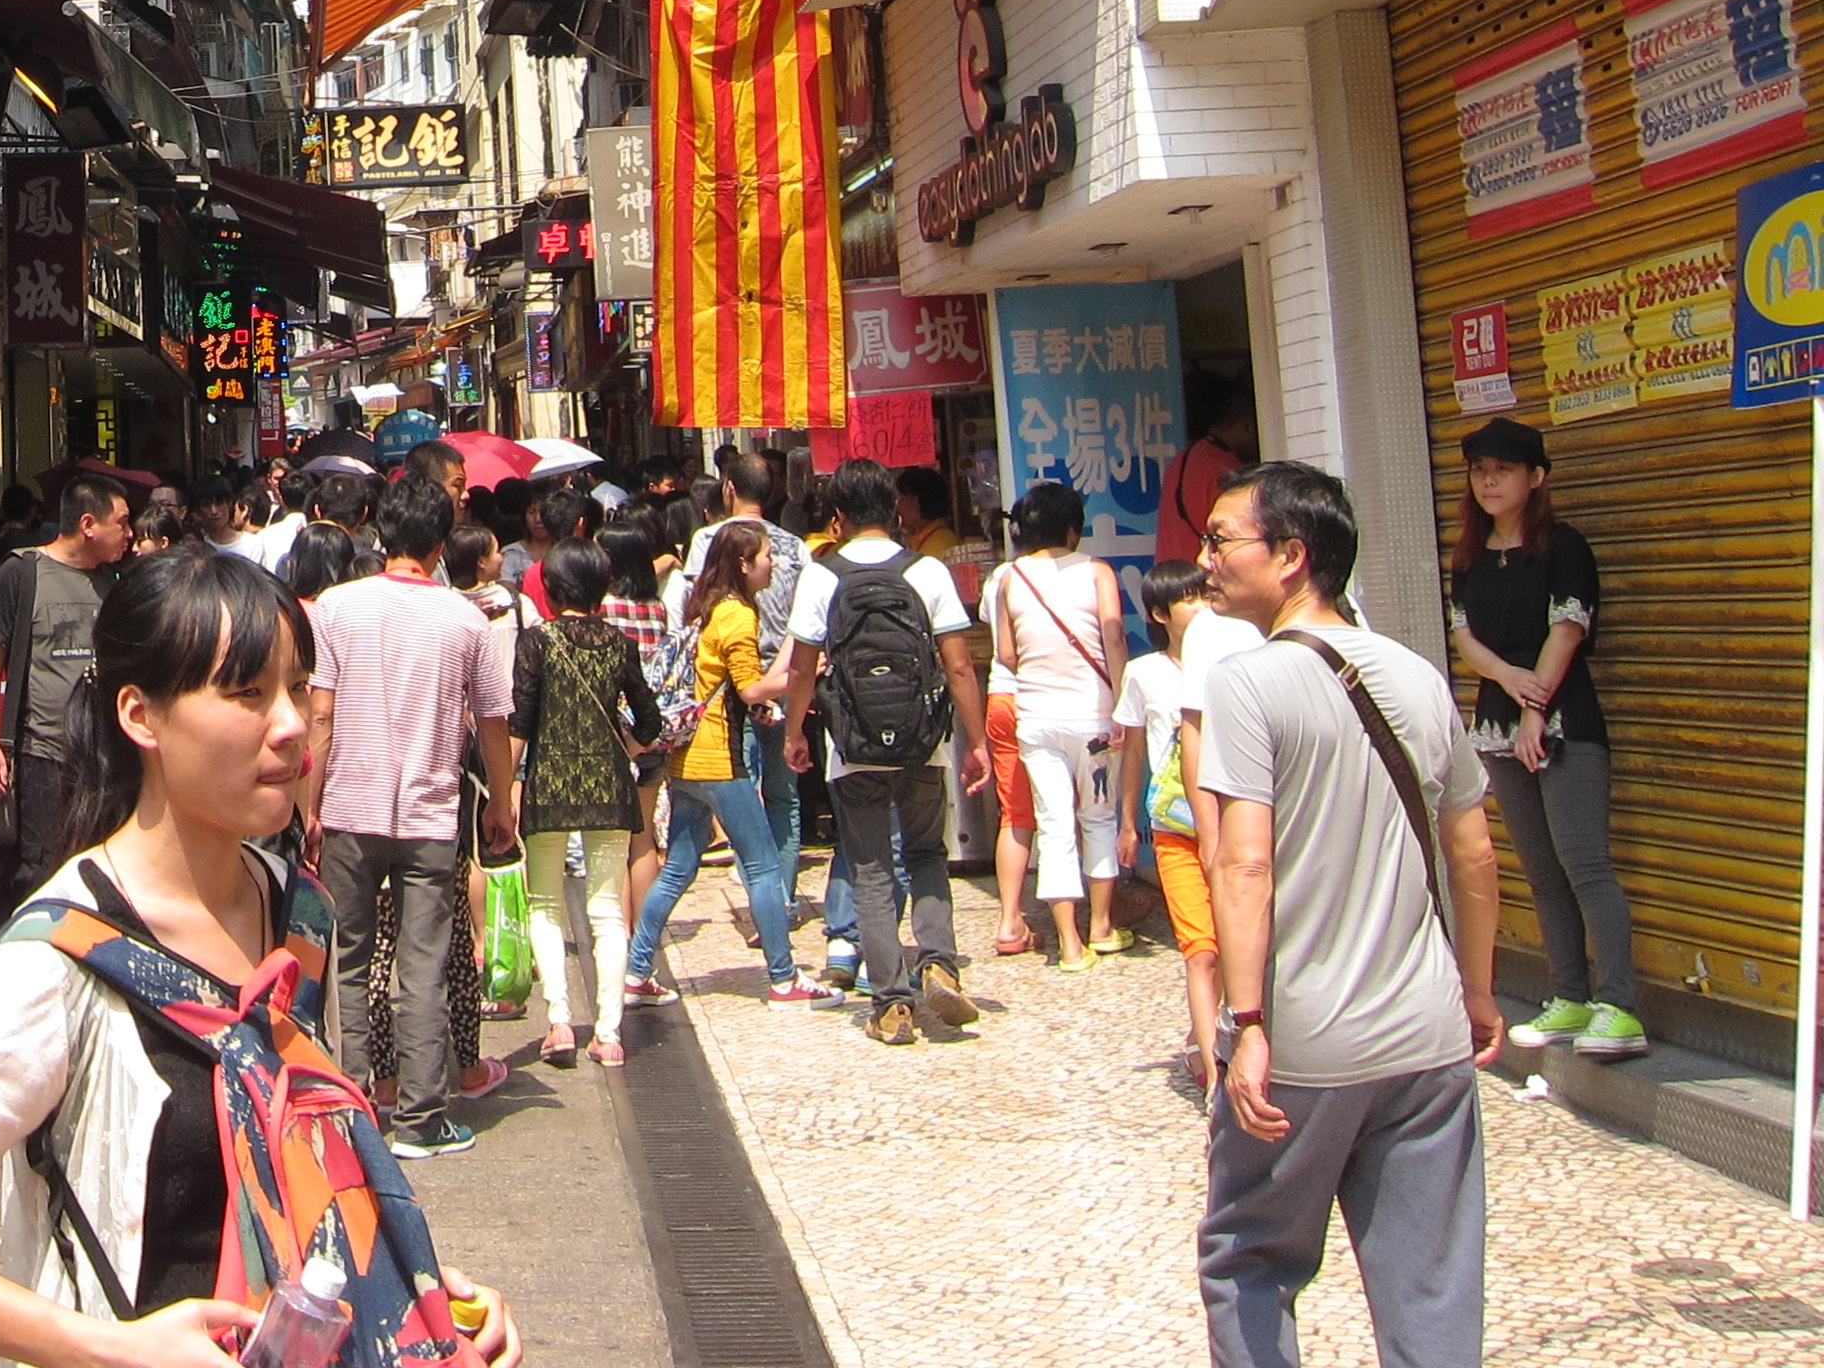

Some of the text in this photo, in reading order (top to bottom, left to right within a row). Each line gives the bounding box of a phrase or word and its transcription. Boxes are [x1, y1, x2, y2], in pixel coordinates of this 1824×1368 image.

[330, 113, 352, 159] 手信
[13, 175, 79, 328] 鳳城
[255, 318, 276, 374] 老澳門
[847, 299, 980, 371] 鳳城
[1010, 324, 1171, 375] 夏季大減價
[1018, 392, 1177, 495] 全場3件
